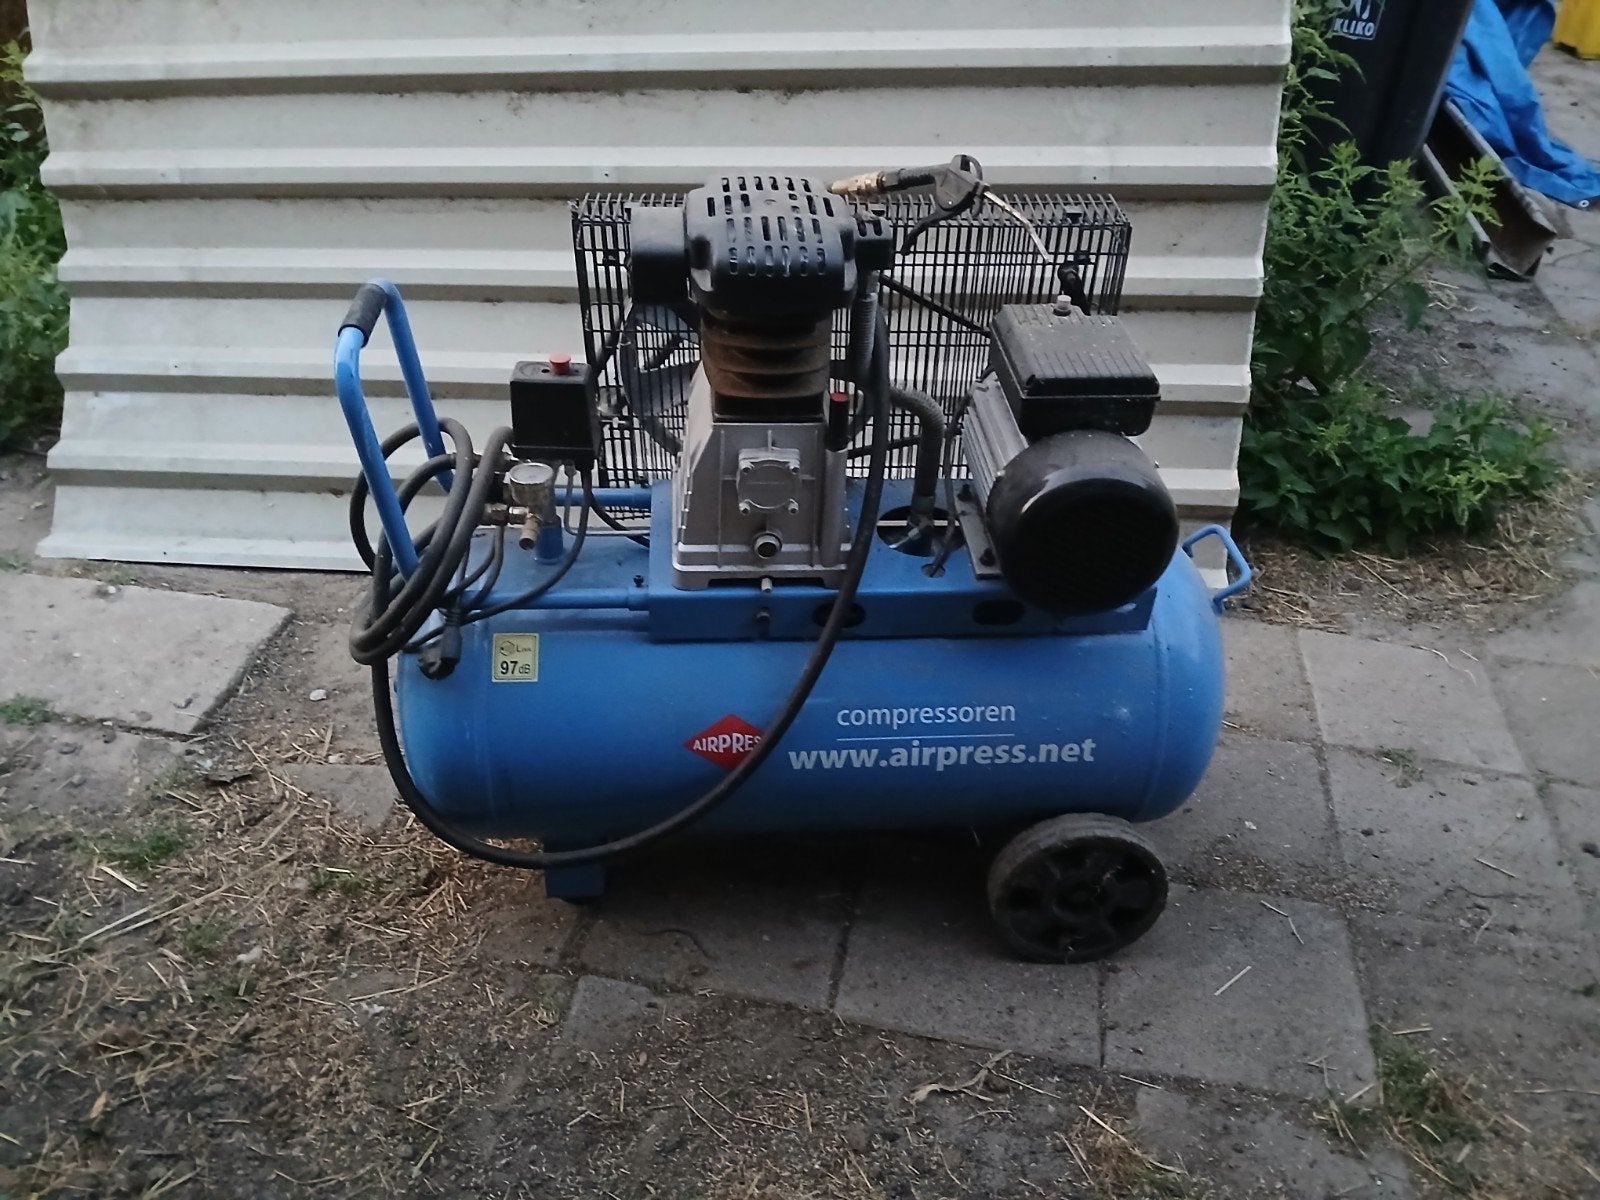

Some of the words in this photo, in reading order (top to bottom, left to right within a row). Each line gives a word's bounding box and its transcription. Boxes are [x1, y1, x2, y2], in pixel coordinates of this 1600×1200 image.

[1333, 18, 1375, 36] KLIKO
[836, 704, 1016, 729] compressoren
[693, 733, 762, 753] AIRPRES
[788, 738, 1097, 771] www.airpress.net
